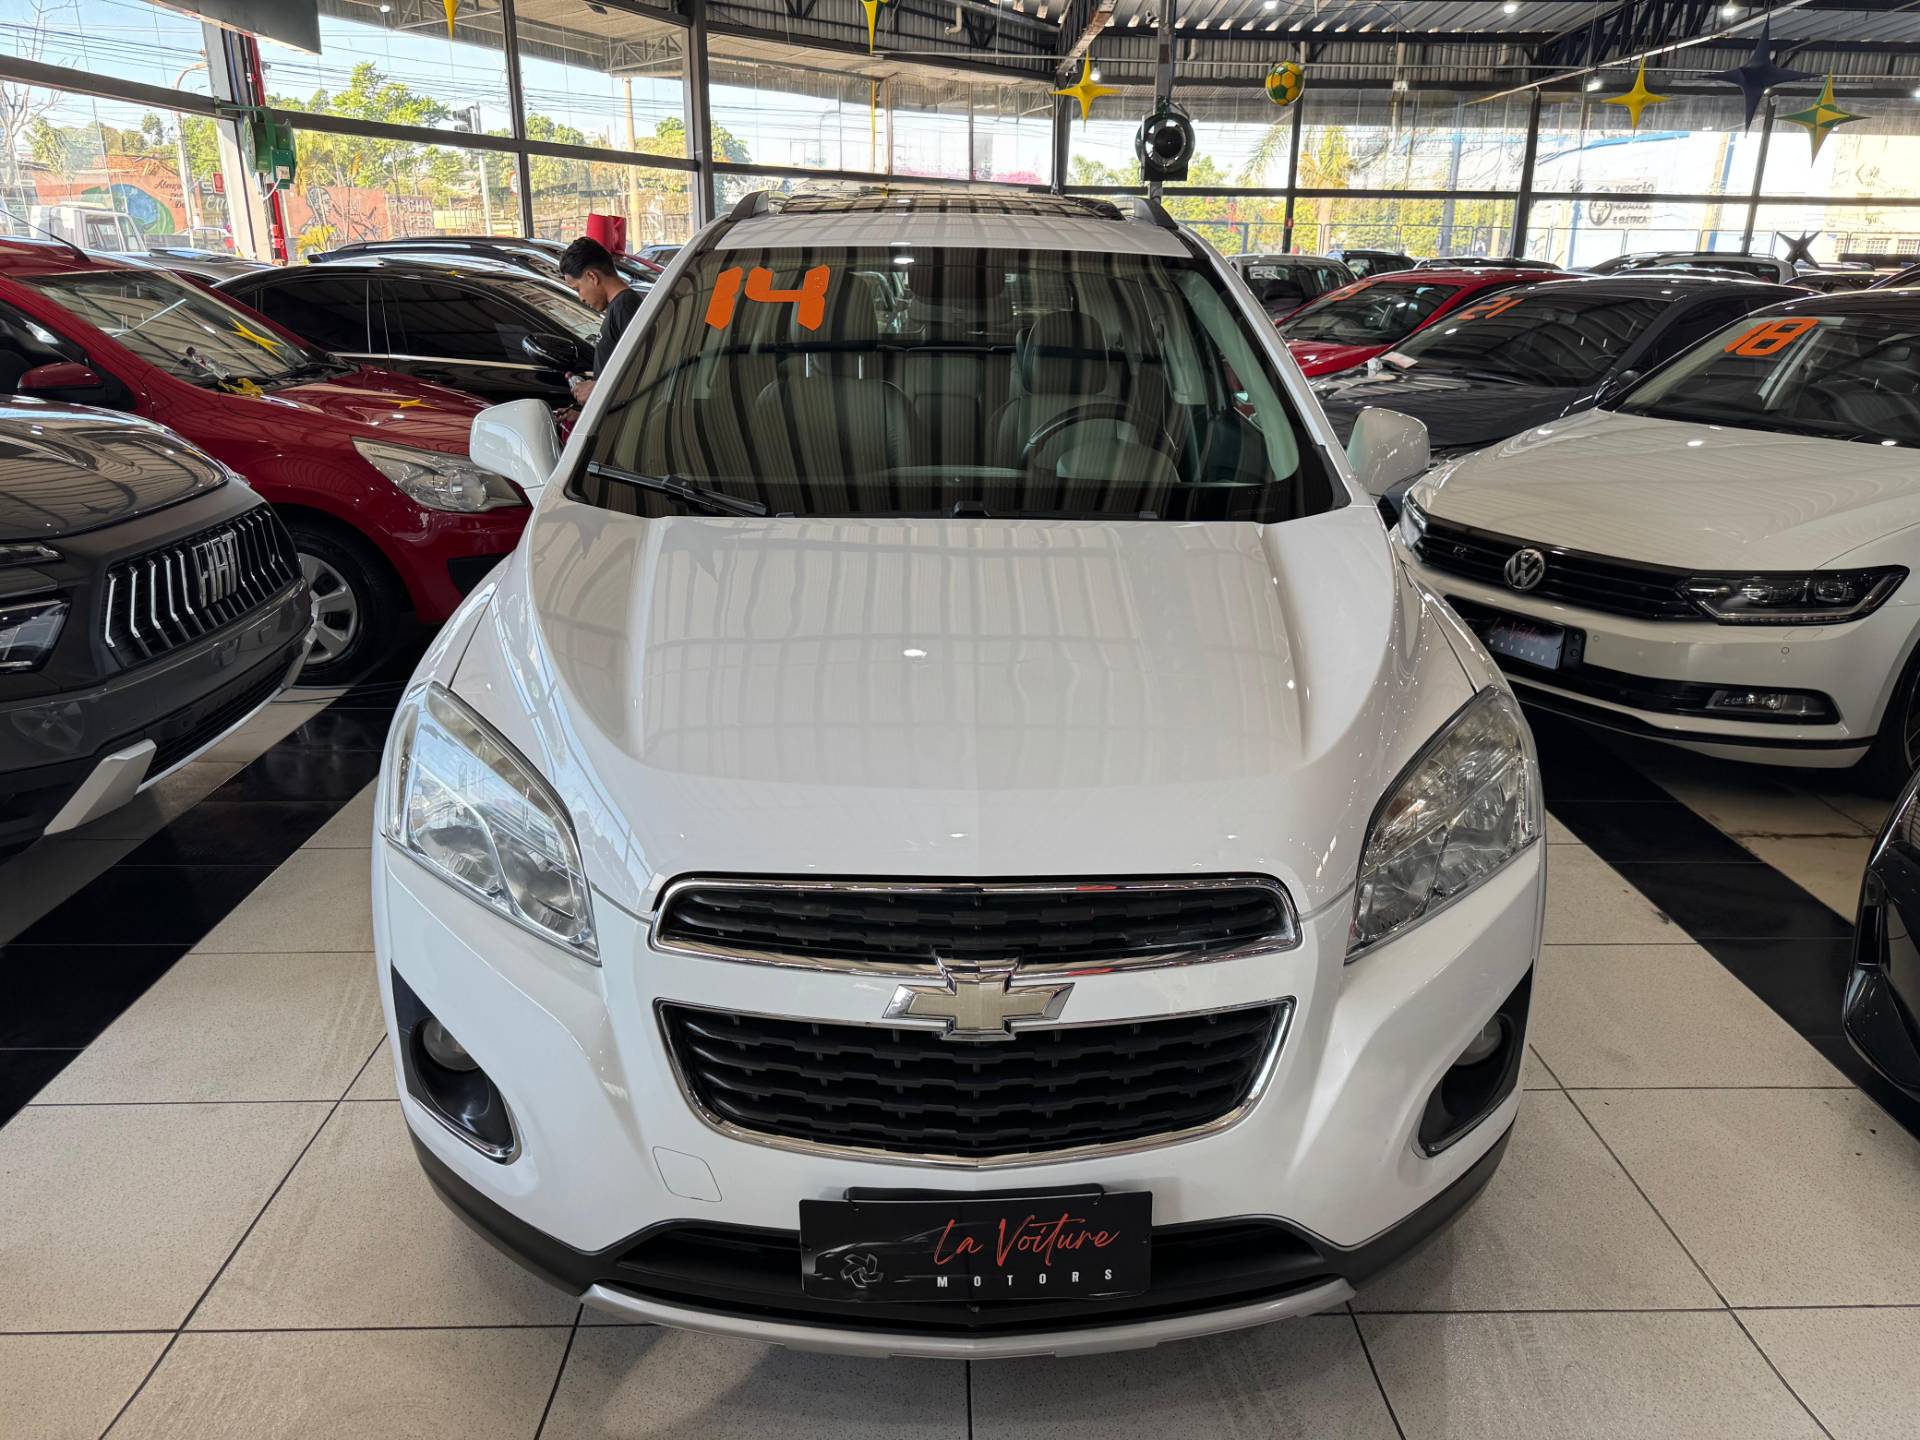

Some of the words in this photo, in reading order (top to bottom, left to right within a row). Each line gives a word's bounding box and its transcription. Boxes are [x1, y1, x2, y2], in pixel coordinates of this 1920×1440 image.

[704, 264, 831, 331] 14
[1457, 297, 1524, 320] 21
[1724, 318, 1820, 356] 18
[192, 530, 237, 608] FIAT
[933, 1217, 984, 1266] La
[996, 1212, 1121, 1267] Voiture
